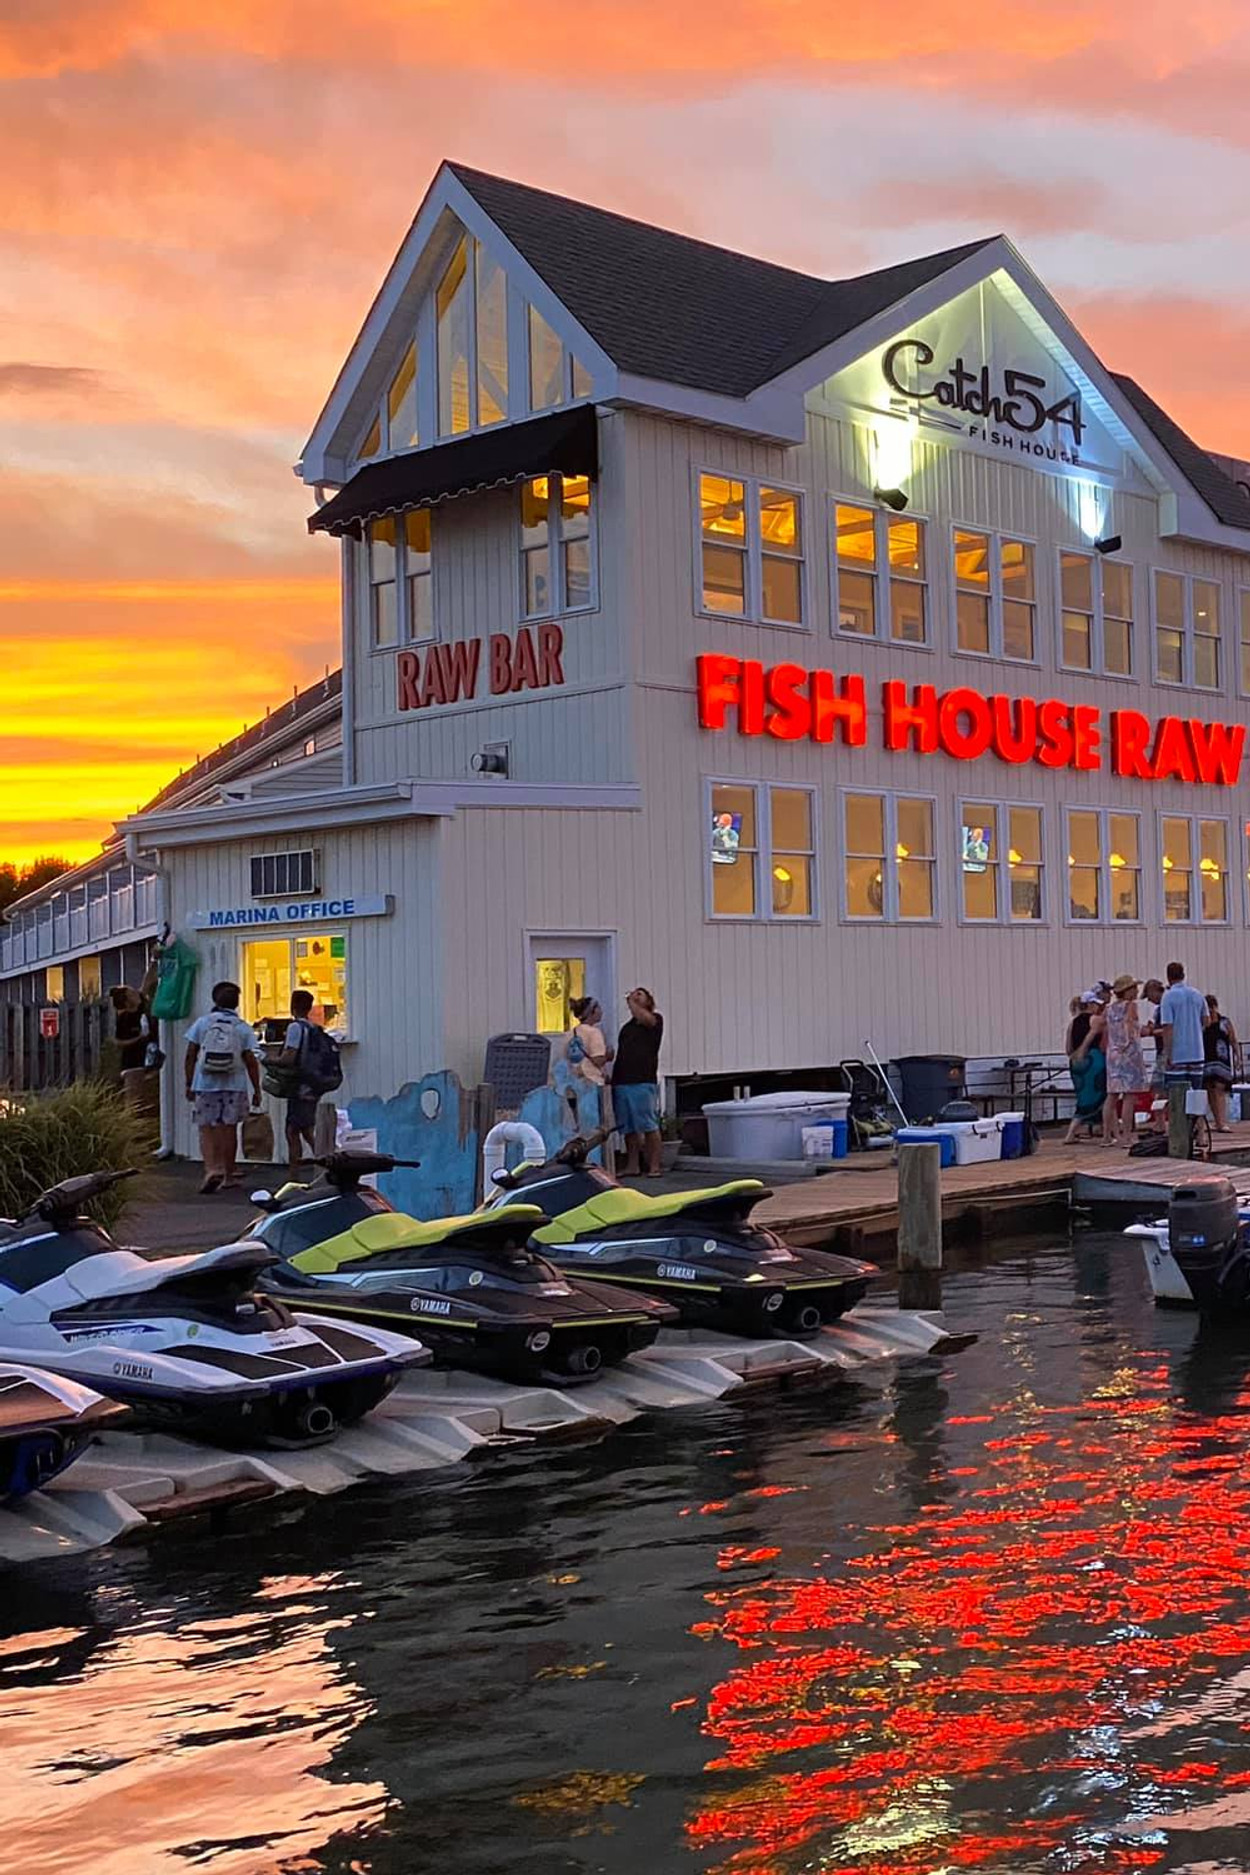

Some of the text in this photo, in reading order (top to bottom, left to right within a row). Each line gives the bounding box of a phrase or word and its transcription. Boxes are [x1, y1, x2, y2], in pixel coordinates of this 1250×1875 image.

[968, 425, 1081, 466] FISH HOUSE
[397, 623, 565, 711] RAW BAR
[696, 652, 868, 747] FISH
[881, 678, 1101, 772] HOUSE
[1109, 708, 1246, 786] RAW
[209, 899, 355, 926] MARINA OFFICE
[420, 1299, 451, 1315] YAMAHA
[122, 1363, 153, 1380] YAMAHA
